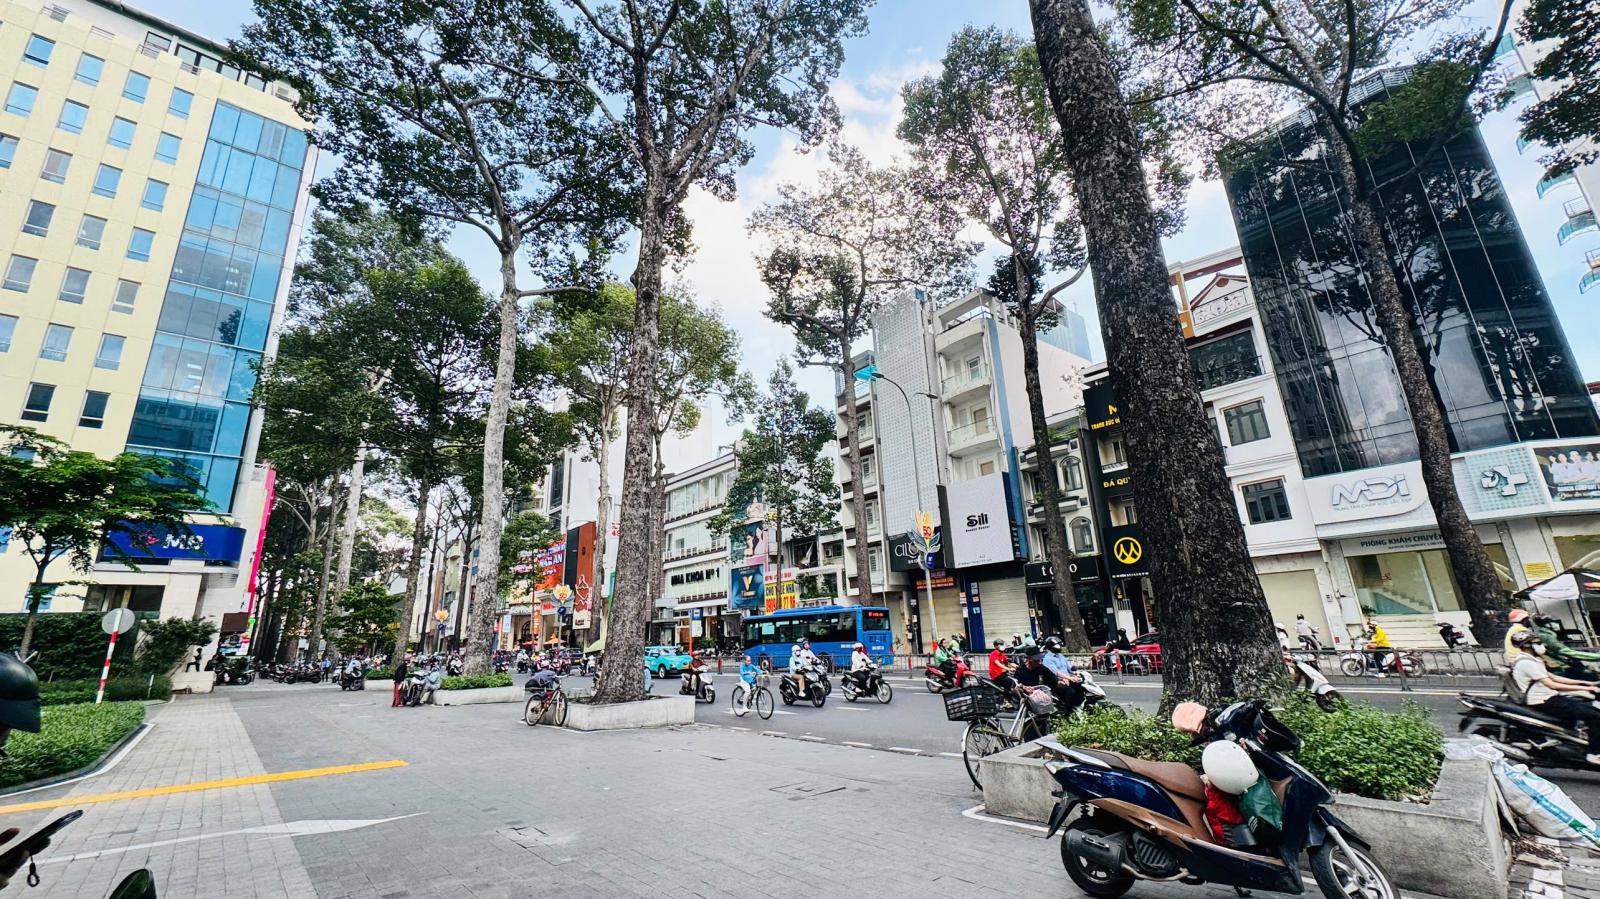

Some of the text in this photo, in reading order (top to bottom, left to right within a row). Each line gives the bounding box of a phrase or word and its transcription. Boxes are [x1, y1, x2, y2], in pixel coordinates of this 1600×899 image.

[1103, 476, 1130, 488] ĐÁ QU
[1332, 473, 1410, 506] MDI
[966, 512, 989, 528] Sili
[1360, 538, 1387, 548] PHÒNG
[1388, 535, 1412, 545] KHÁM
[685, 570, 704, 583] KHOA
[715, 567, 720, 578] 1
